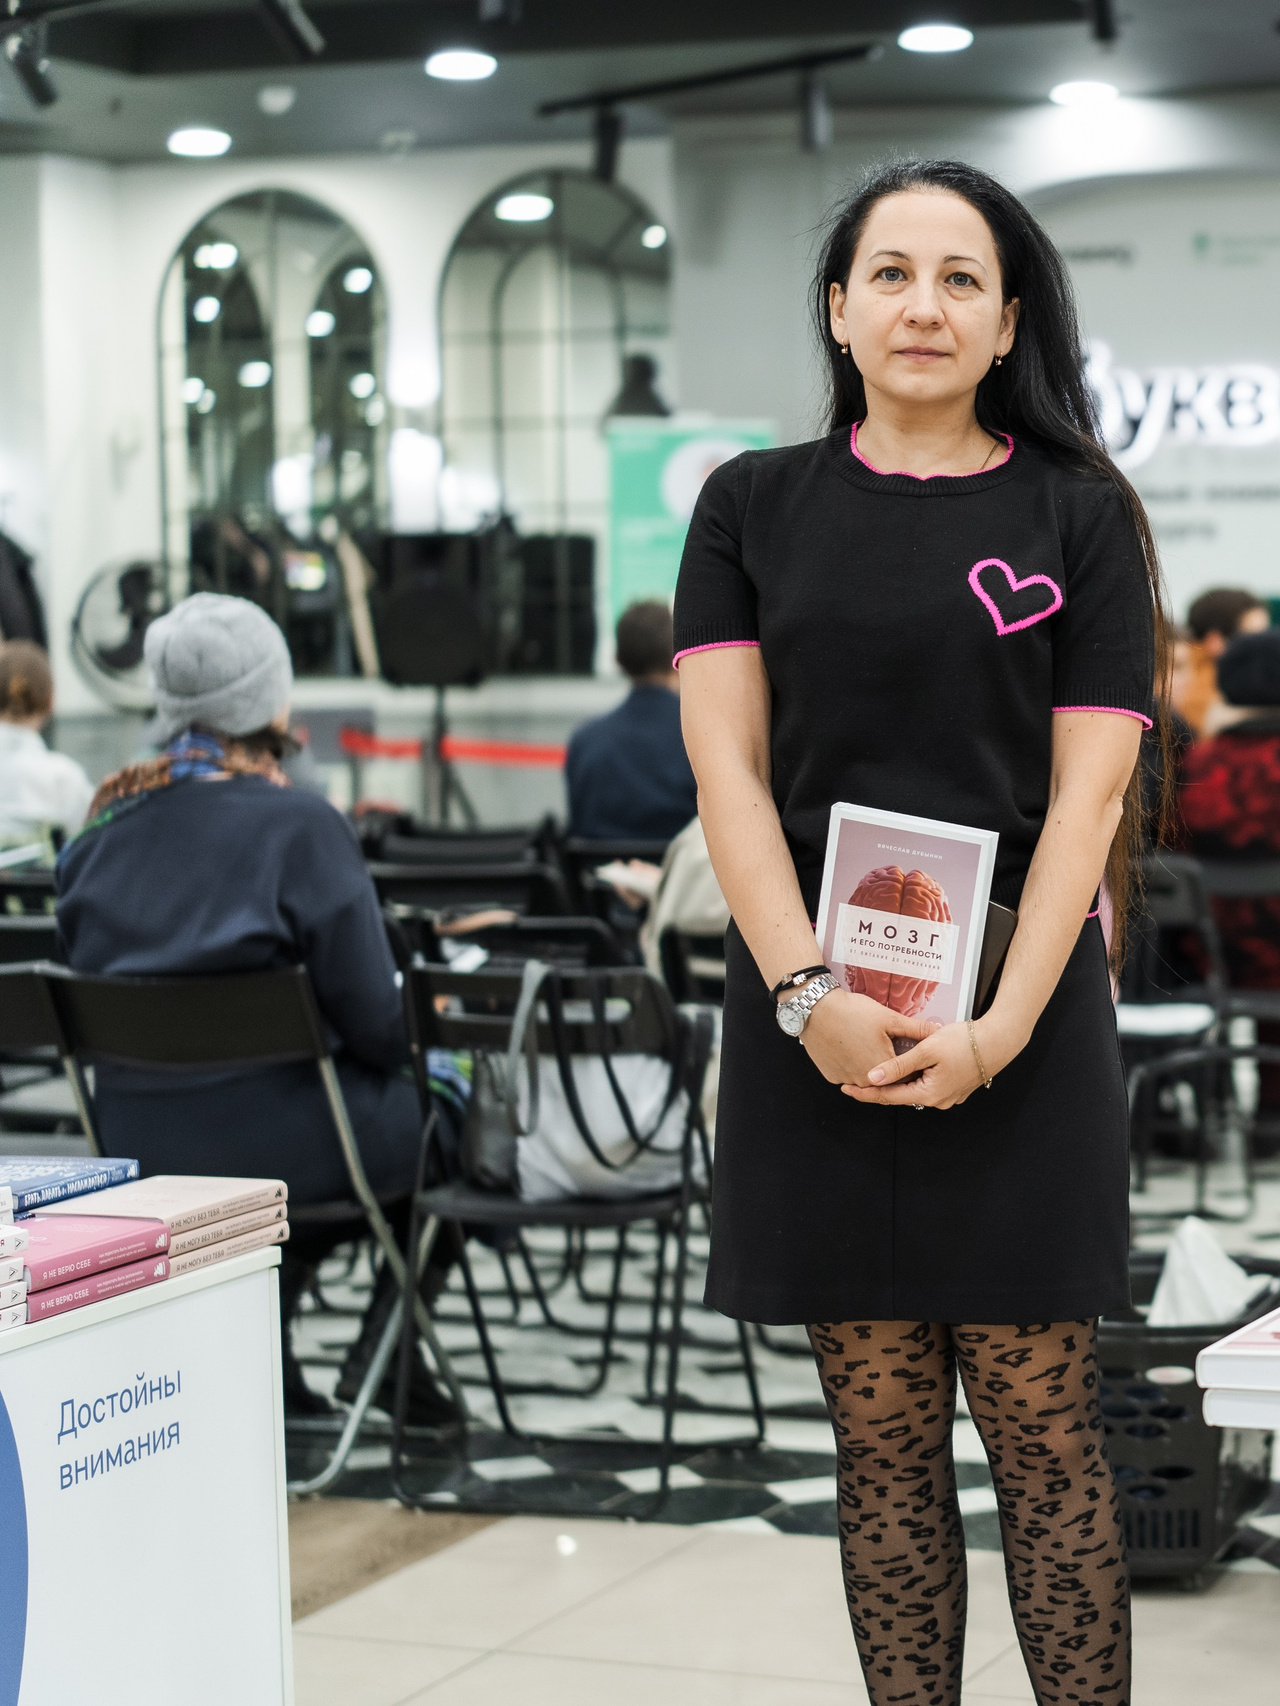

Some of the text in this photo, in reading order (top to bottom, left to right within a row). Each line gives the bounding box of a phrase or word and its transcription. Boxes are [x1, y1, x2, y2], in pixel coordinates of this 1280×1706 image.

[859, 938, 875, 948] ЕГО
[877, 942, 942, 960] ПОТРЕБНОСТИ
[175, 1220, 182, 1228] НЕ
[183, 1215, 196, 1226] МОГУ
[198, 1212, 207, 1221] БЕЗ
[208, 1208, 220, 1218] ТЕБЯ
[180, 1241, 186, 1249] НЕ
[187, 1236, 200, 1247] МОГУ
[201, 1233, 211, 1243] БЕЗ
[211, 1229, 223, 1240] ТЕБЯ
[43, 1271, 47, 1280] Я
[48, 1269, 57, 1279] НЕ
[58, 1264, 75, 1276] ВЕРЮ
[76, 1259, 91, 1271] СЕБЕ
[181, 1262, 188, 1270] НЕ
[188, 1258, 202, 1269] МОГУ
[202, 1254, 212, 1264] БЕЗ
[212, 1250, 225, 1260] ТЕБЯ
[41, 1302, 45, 1310] Я
[46, 1298, 55, 1309] НЕ
[56, 1294, 73, 1306] ВЕРЮ
[74, 1288, 90, 1300] СЕБЕ
[57, 1371, 181, 1445] Достойны
[60, 1422, 181, 1491] внимания
